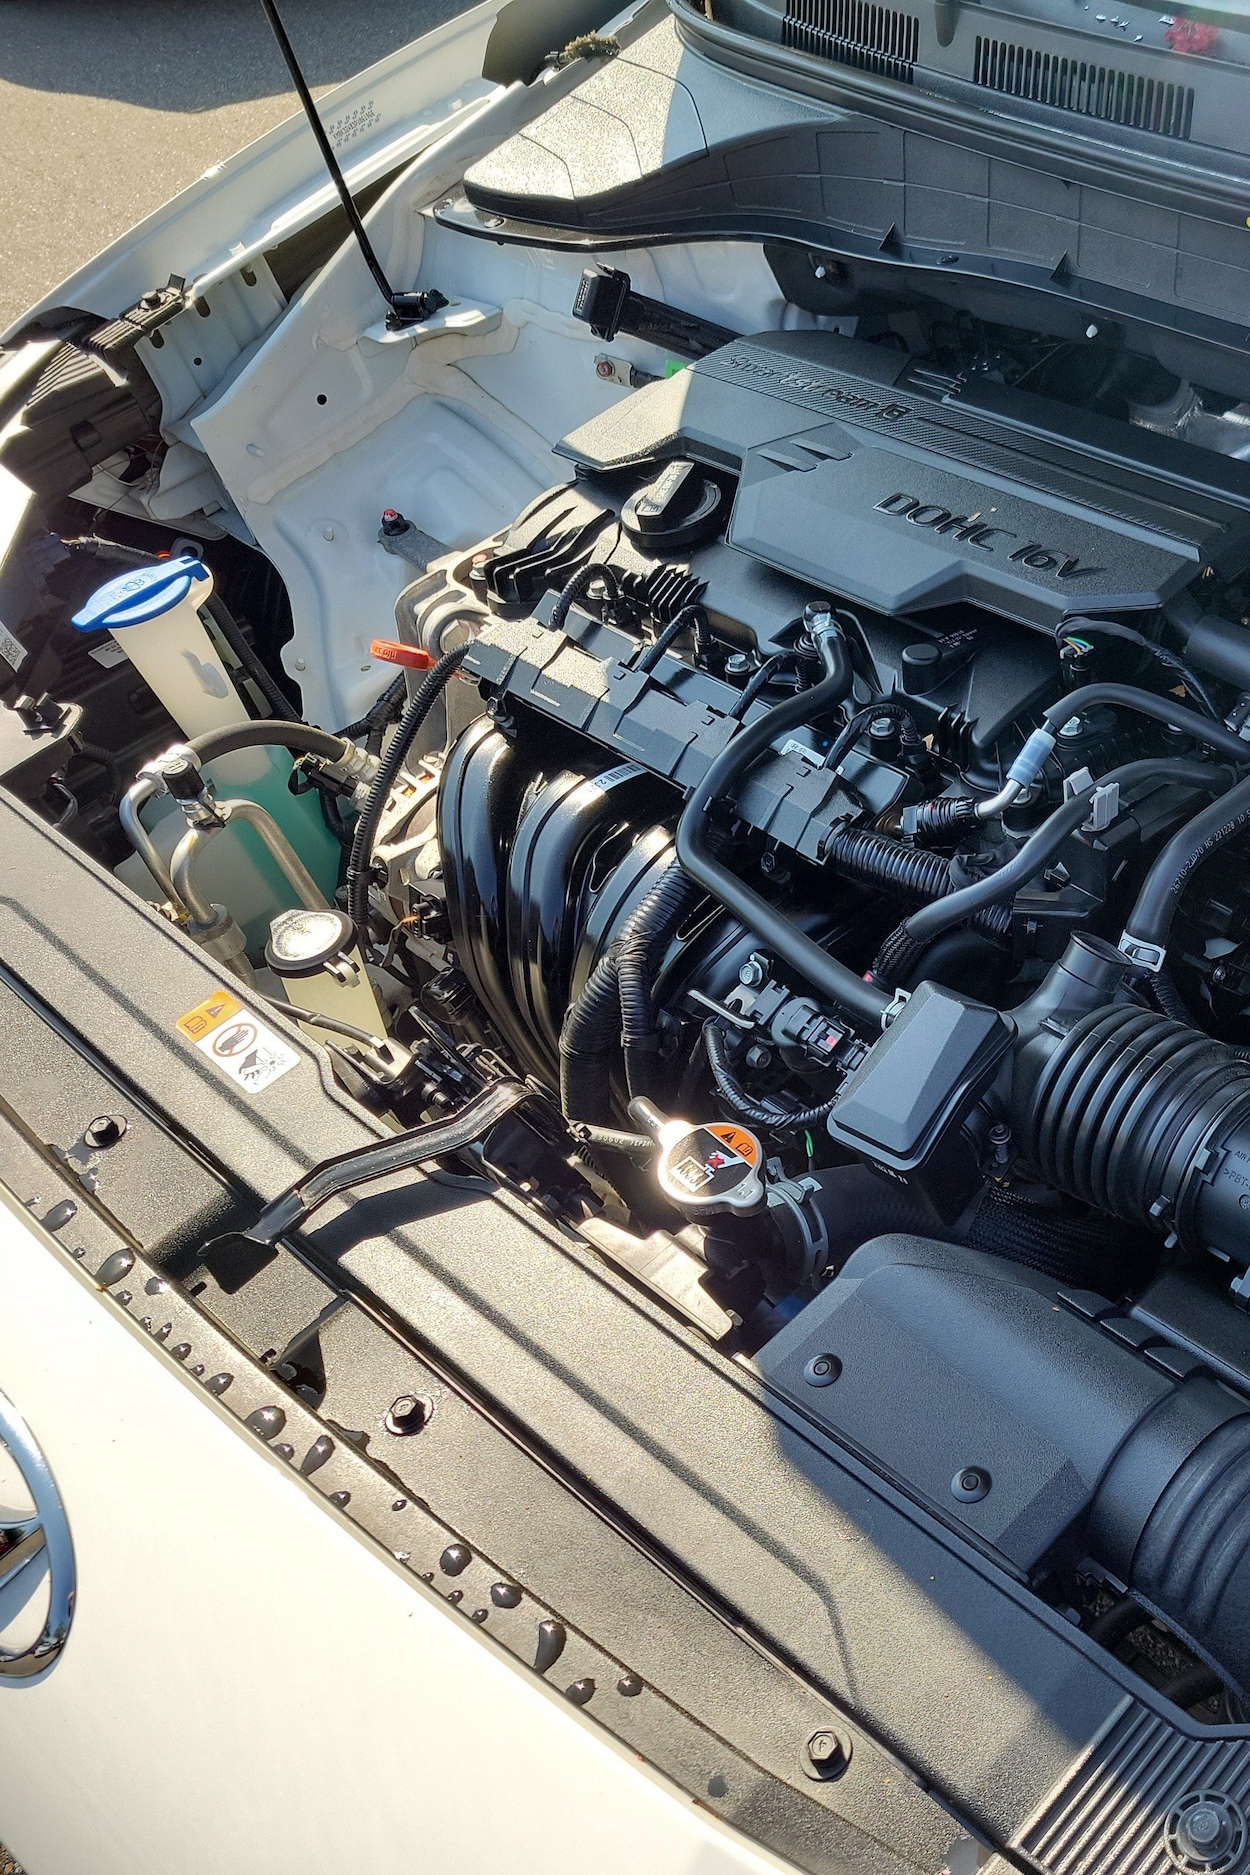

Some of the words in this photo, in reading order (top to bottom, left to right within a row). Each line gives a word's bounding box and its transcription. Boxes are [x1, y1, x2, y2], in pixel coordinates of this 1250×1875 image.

[872, 492, 1017, 551] DOHC
[1007, 540, 1107, 580] 16V
[1204, 838, 1213, 849] HS
[1214, 821, 1236, 841] 221228
[1235, 1151, 1246, 1161] AIR
